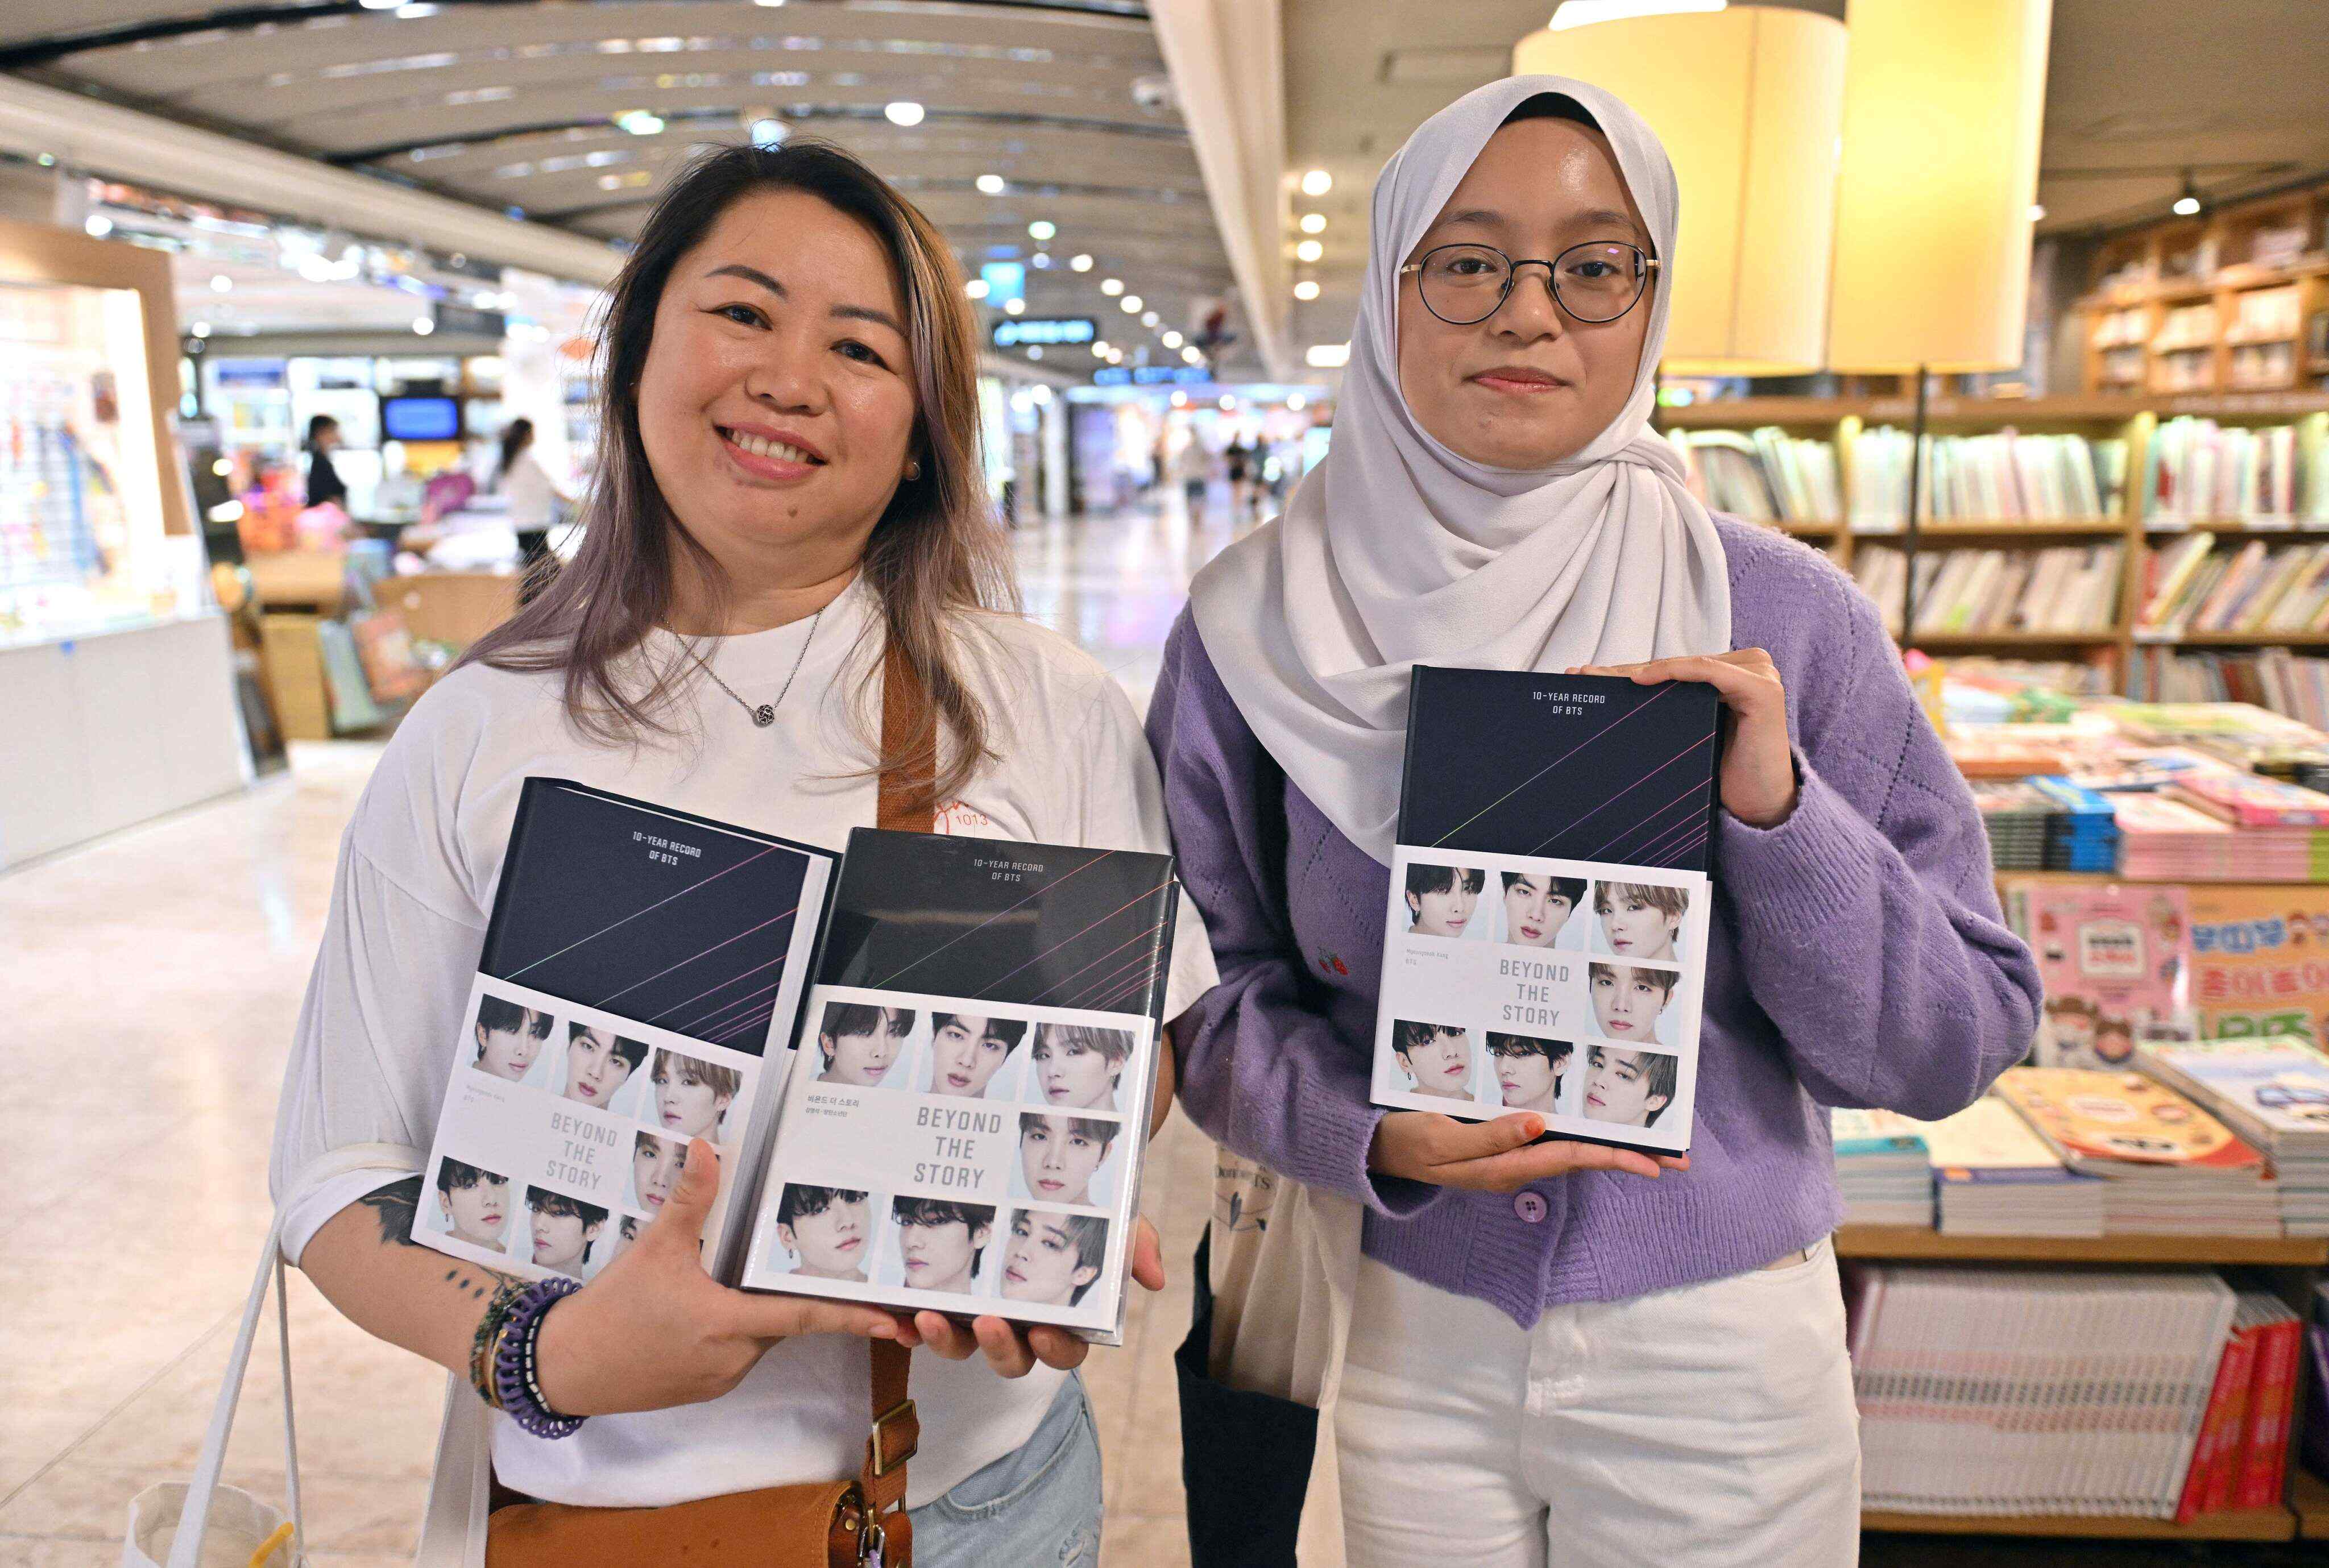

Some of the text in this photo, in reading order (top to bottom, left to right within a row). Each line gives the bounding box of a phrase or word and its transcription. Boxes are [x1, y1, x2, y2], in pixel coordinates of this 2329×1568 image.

[1533, 692, 1605, 704] 10-YEAR RECORD
[1566, 707, 1582, 715] BTS
[956, 814, 988, 826] 1013
[633, 831, 702, 857] 10-YEAR RECORD
[649, 851, 678, 865] OF BTS
[974, 859, 1043, 872] 10-YEAR RECORD
[1004, 873, 1021, 882] BTS
[1500, 959, 1569, 982] BEYOND
[1516, 984, 1549, 1002] THE
[1503, 1005, 1560, 1026] STORY
[807, 1095, 859, 1107] 비욘드 더 스토리
[551, 1112, 618, 1147] BEYOND
[917, 1107, 1001, 1134] BEYOND
[565, 1140, 596, 1164] THE
[936, 1136, 975, 1159] THE
[546, 1160, 602, 1190] STORY
[914, 1163, 985, 1188] STORY
